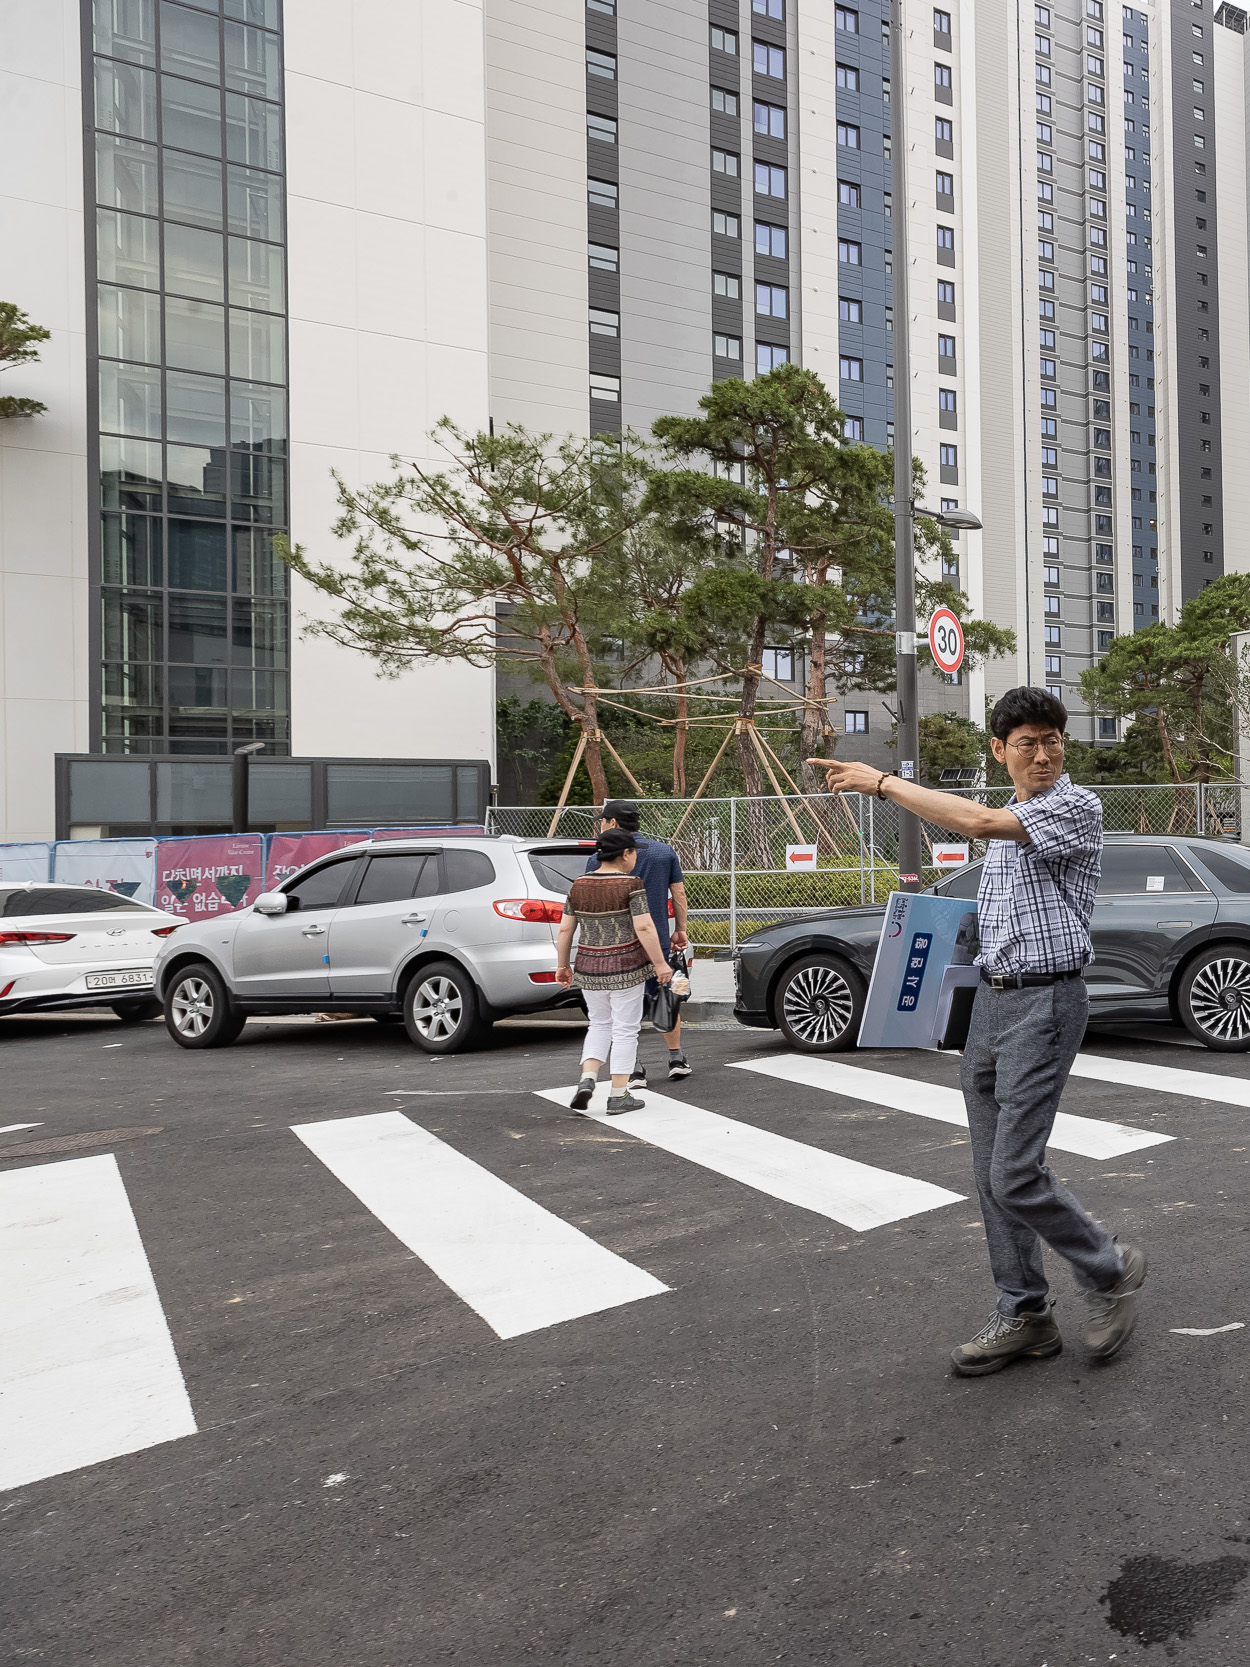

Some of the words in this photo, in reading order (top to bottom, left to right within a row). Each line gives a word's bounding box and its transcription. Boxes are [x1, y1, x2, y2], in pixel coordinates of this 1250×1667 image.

[937, 625, 957, 656] 30
[162, 864, 244, 886] 다치면서까지
[121, 973, 148, 984] 6831
